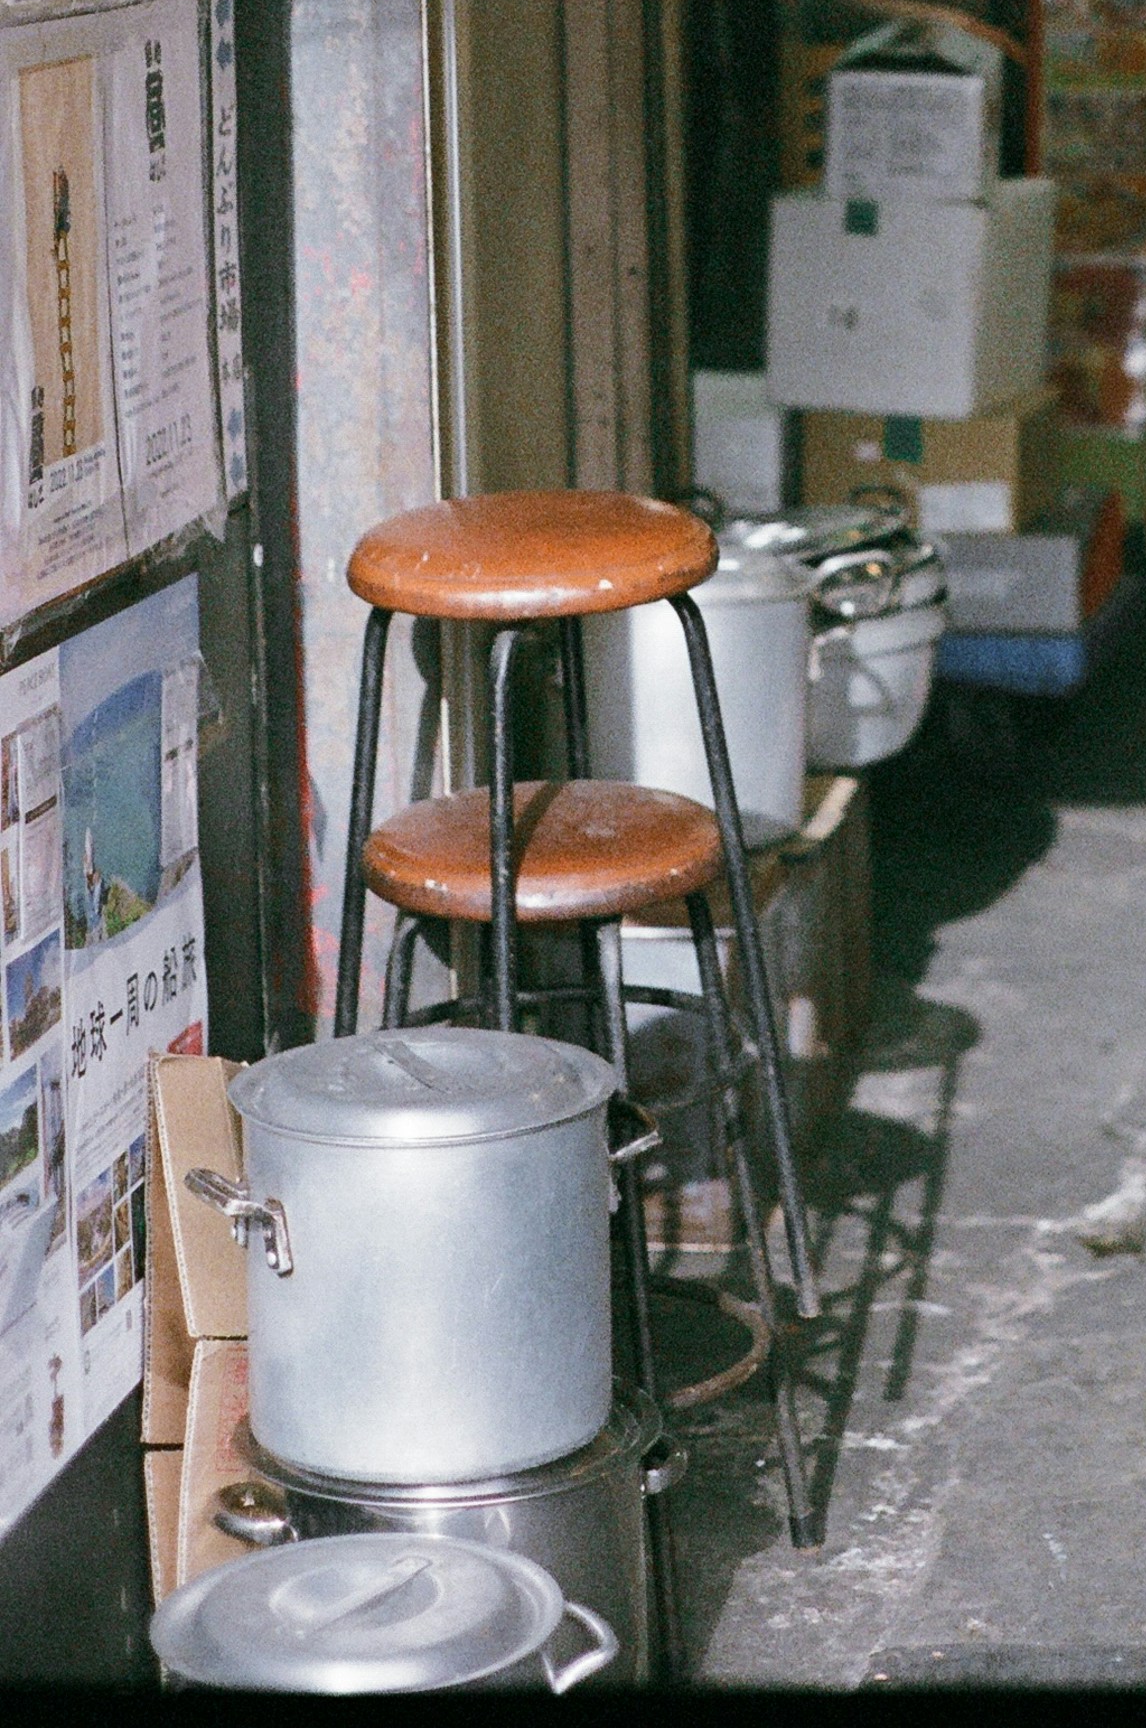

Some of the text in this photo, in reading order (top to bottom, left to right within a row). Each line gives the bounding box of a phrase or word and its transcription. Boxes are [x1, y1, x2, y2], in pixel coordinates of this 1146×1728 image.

[71, 932, 197, 1078] 地球一周の船旅
